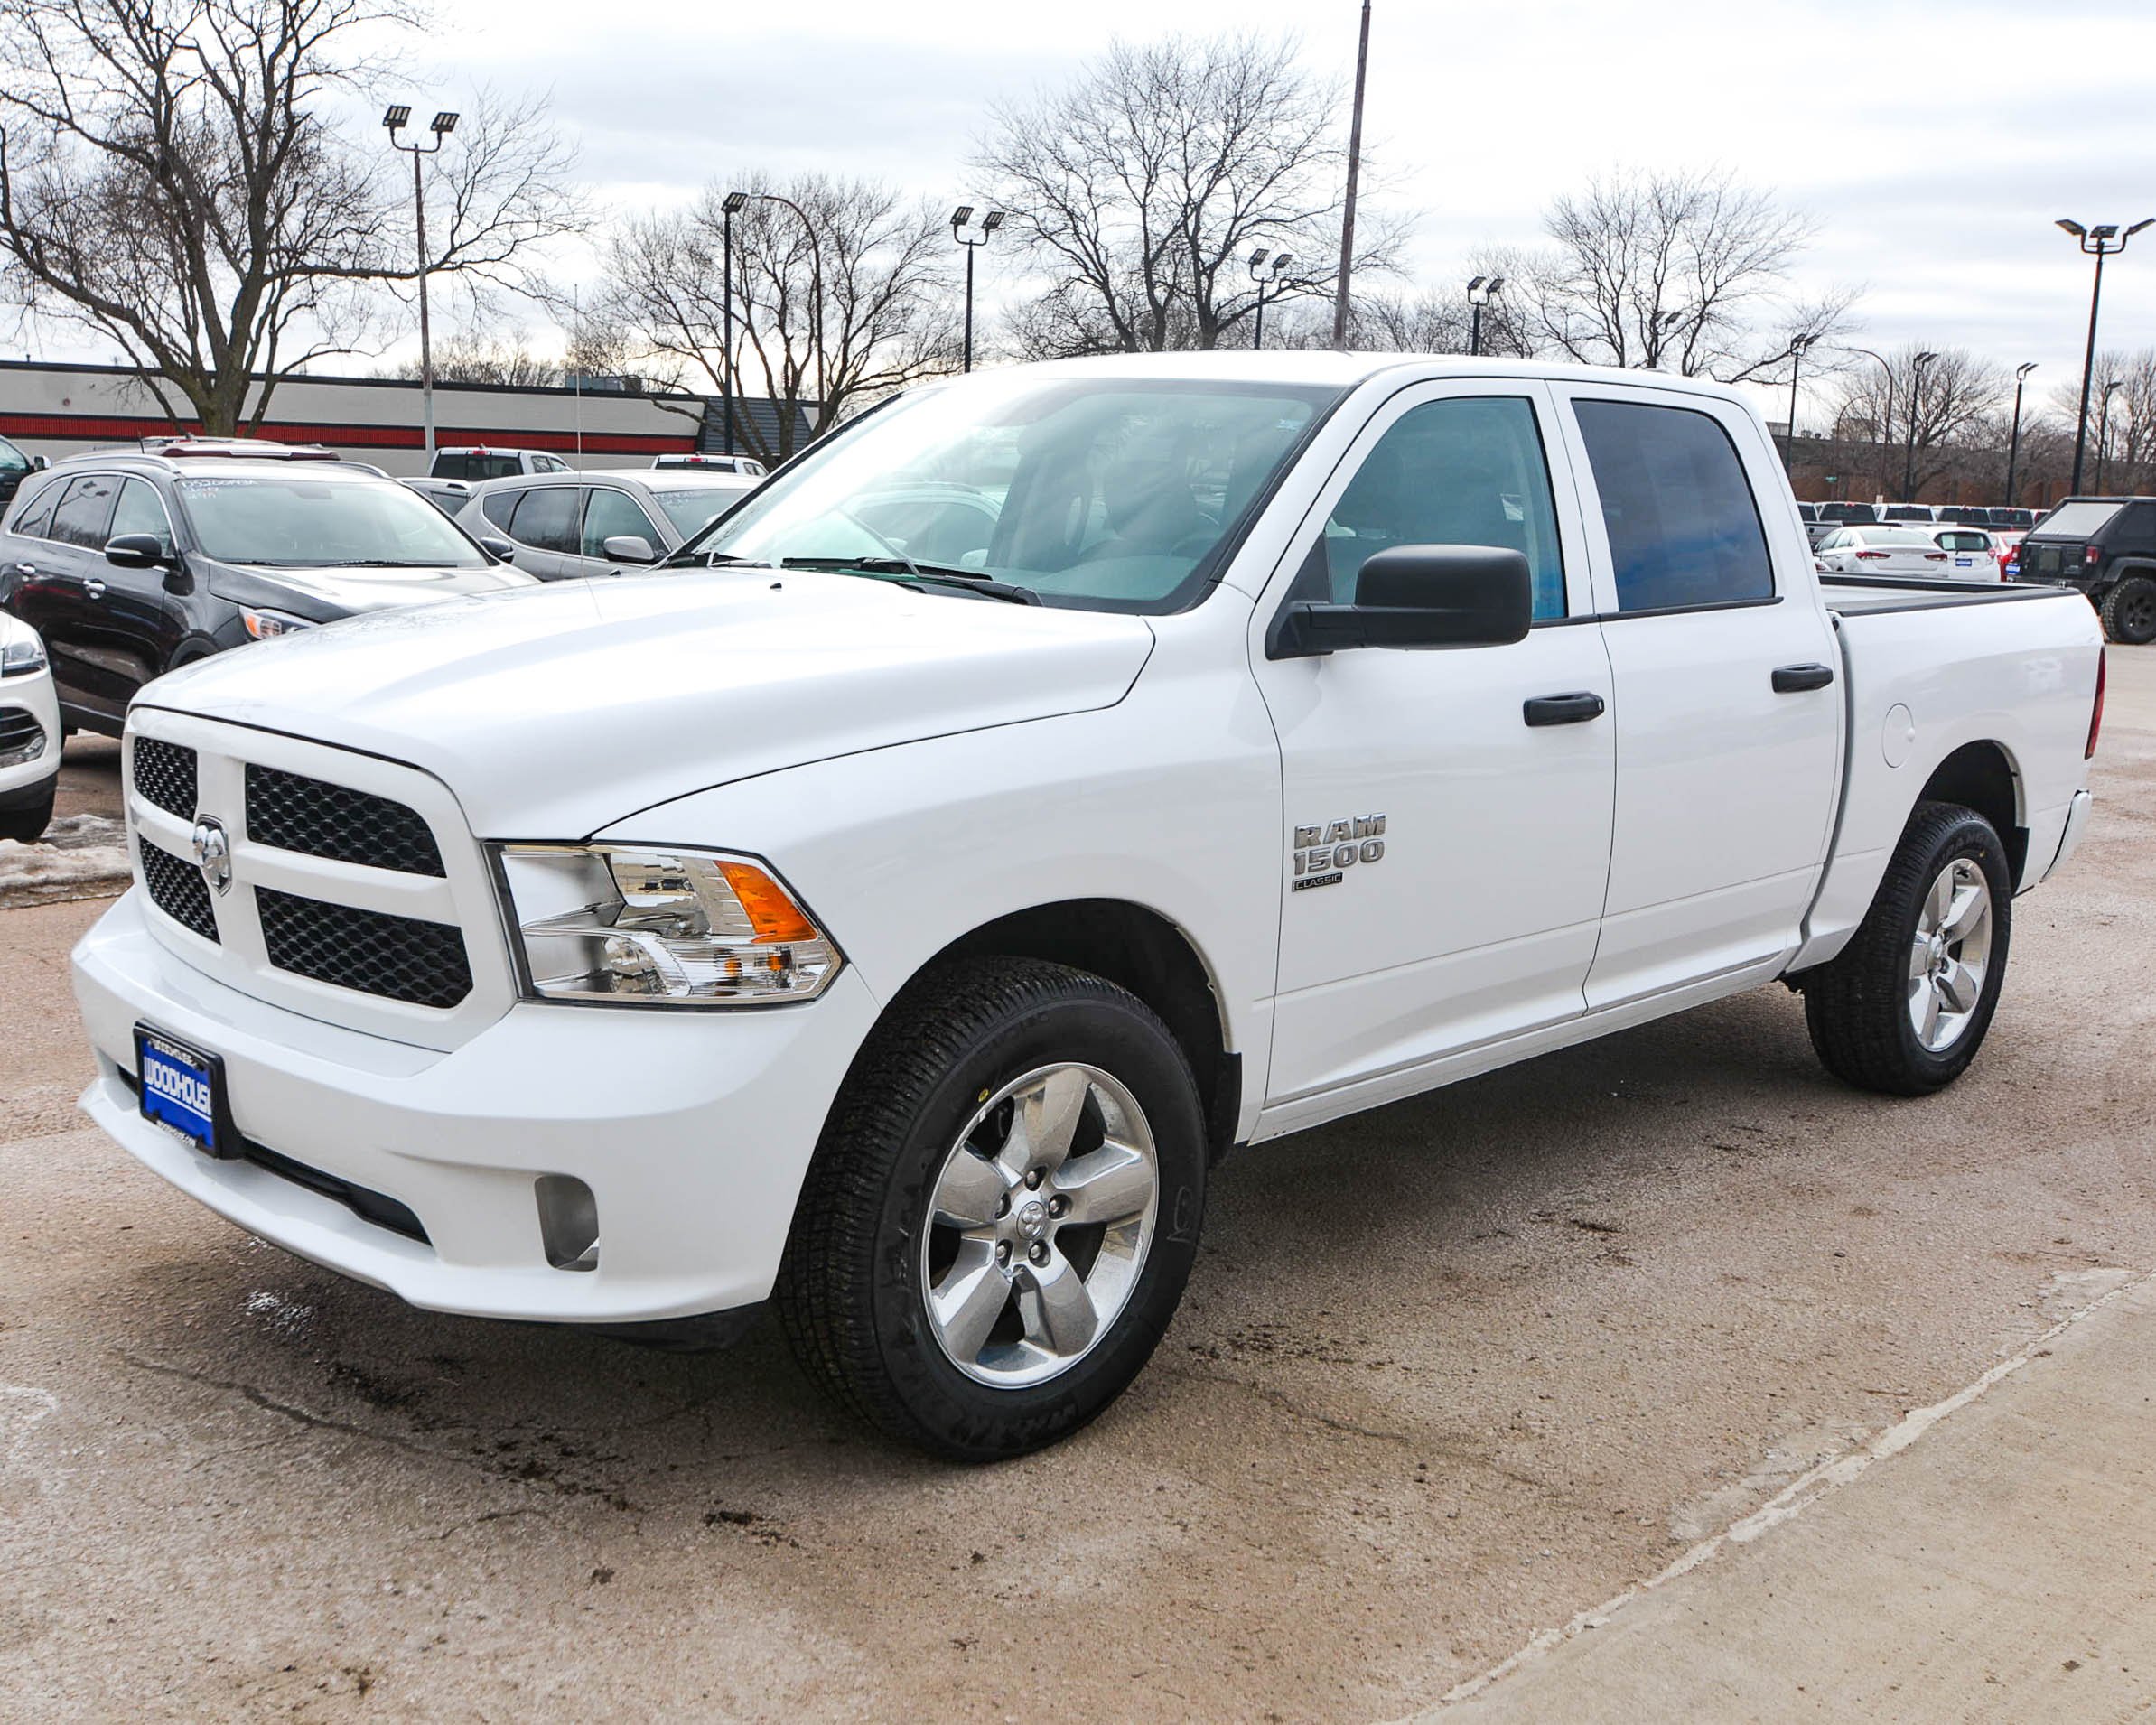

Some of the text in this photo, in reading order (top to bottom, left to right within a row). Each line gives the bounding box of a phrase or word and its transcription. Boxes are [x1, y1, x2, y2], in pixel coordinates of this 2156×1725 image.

[1294, 813, 1386, 849] RAM
[1293, 838, 1384, 876] 1500
[1295, 873, 1341, 890] CLASSIC
